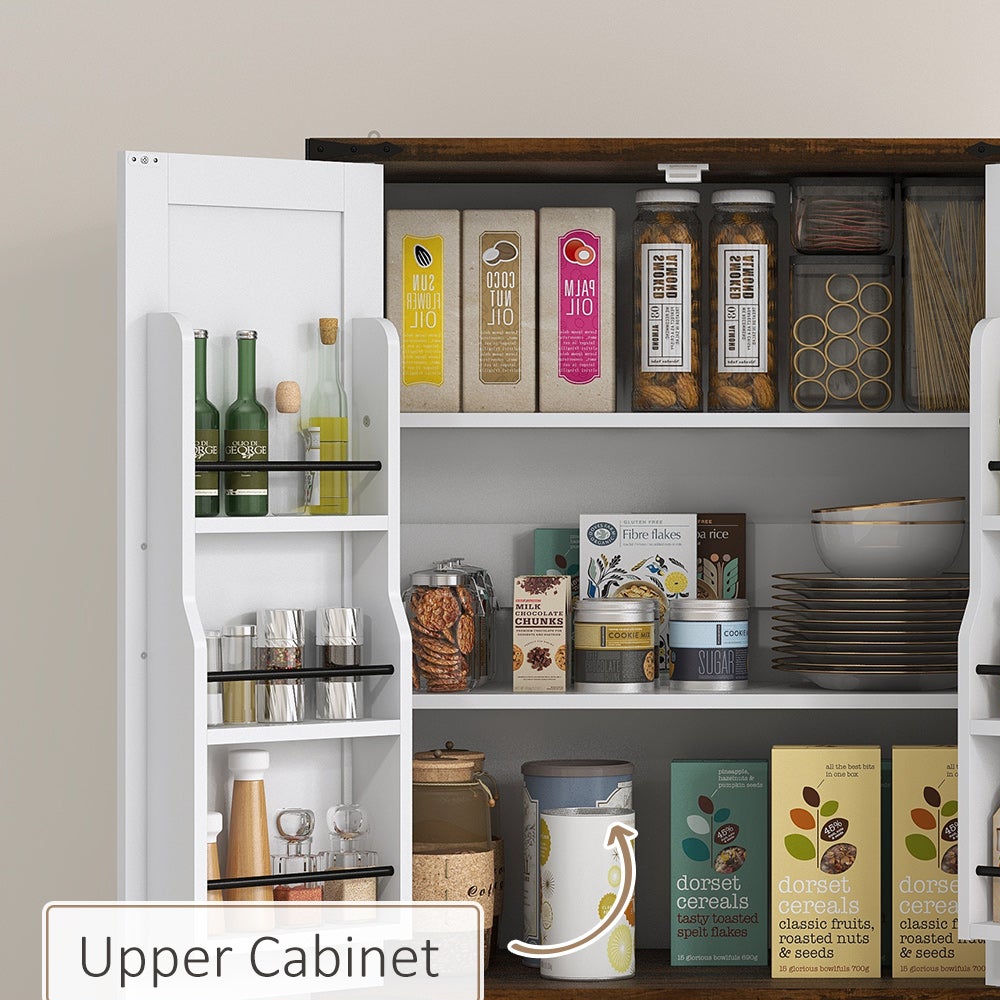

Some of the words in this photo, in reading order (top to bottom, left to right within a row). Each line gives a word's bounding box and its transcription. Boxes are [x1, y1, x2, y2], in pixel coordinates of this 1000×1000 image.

[225, 445, 267, 455] GEORGE
[622, 528, 649, 540] Fibre
[651, 528, 682, 540] flakes
[709, 528, 729, 539] rice
[515, 617, 564, 625] CHUNKS
[698, 649, 735, 675] SUGAR
[676, 874, 741, 891] dorset
[778, 875, 851, 894] dorset
[899, 875, 958, 894] dorse
[676, 893, 749, 910] cereals
[778, 896, 860, 915] cereals
[899, 899, 958, 915] cerea
[677, 912, 709, 926] tasty
[712, 912, 759, 924] toasted
[779, 917, 828, 930] classic
[831, 917, 875, 932] fruits,
[899, 917, 948, 930] classic
[677, 927, 709, 940] spelt
[711, 926, 748, 938] flakes
[779, 932, 833, 944] roasted
[836, 933, 870, 944] nuts
[899, 932, 954, 944] roasted
[779, 946, 791, 959] &
[794, 946, 834, 959] seeds
[899, 946, 912, 959] &
[915, 946, 955, 959] seeds
[789, 965, 818, 973] glorious
[851, 965, 870, 973] 700g
[909, 965, 939, 973] glorious
